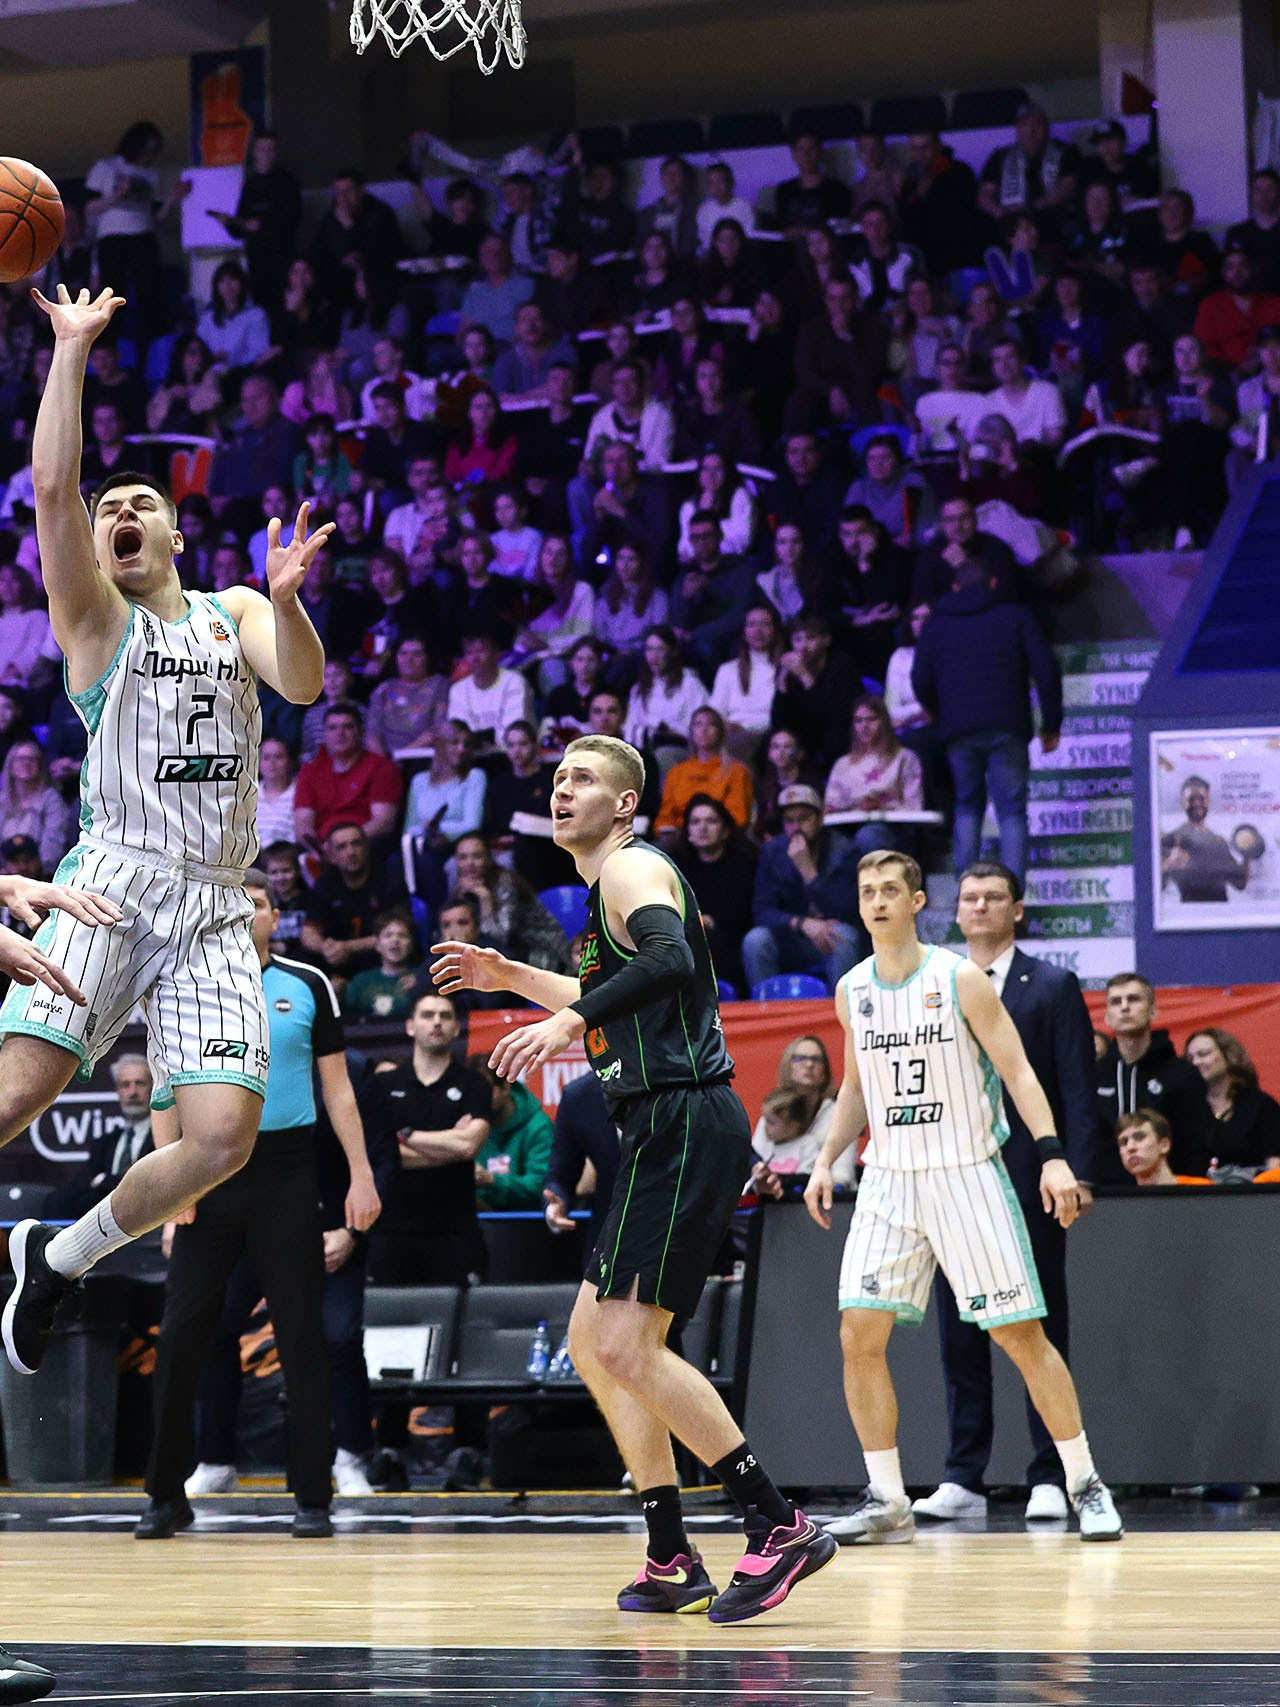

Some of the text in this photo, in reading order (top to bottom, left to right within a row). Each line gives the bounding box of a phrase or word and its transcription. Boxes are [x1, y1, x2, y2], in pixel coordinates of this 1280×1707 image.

[131, 651, 212, 684] Пари
[185, 695, 217, 745] 7
[157, 757, 243, 781] PARI
[861, 1022, 954, 1055] Пари НН
[892, 1058, 926, 1097] 13
[886, 1103, 943, 1126] PARI
[735, 1454, 758, 1476] 23
